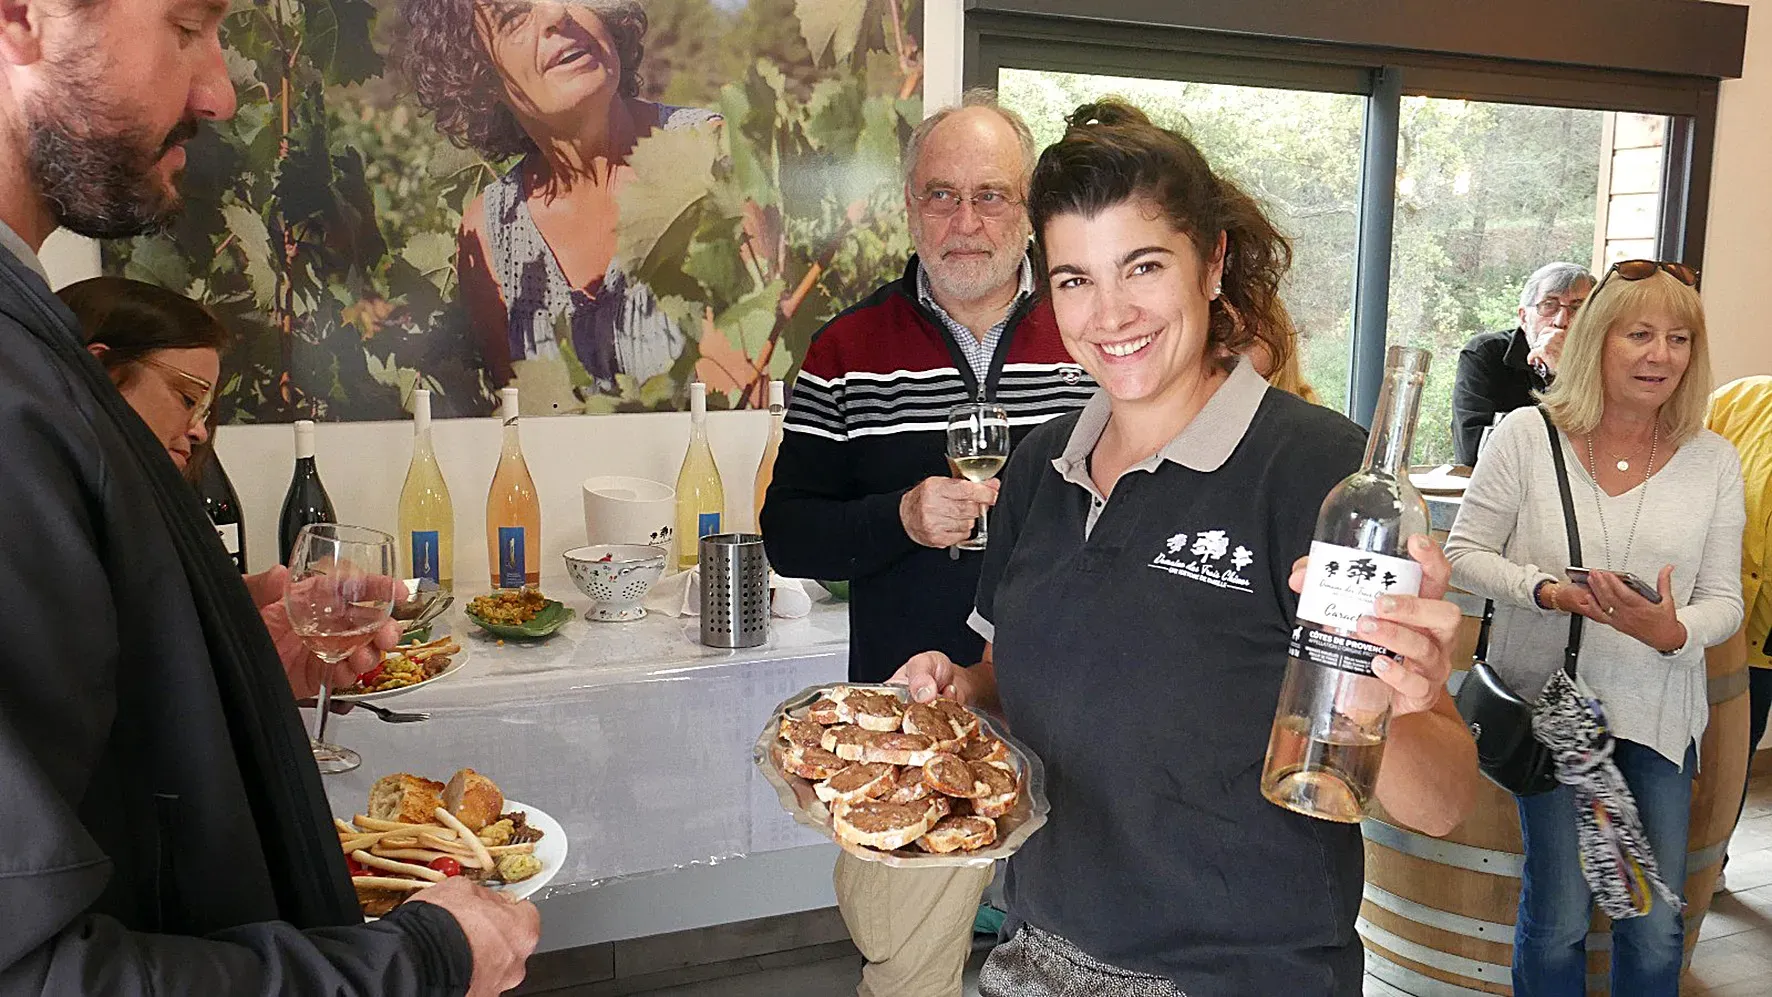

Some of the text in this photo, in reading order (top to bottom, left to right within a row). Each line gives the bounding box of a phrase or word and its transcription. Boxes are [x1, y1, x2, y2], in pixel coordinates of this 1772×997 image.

[1201, 564, 1220, 578] Trois
[1324, 603, 1363, 622] Caract
[1309, 630, 1333, 643] CÔTES
[1333, 636, 1345, 646] DE
[1345, 639, 1387, 655] PROVENCE
